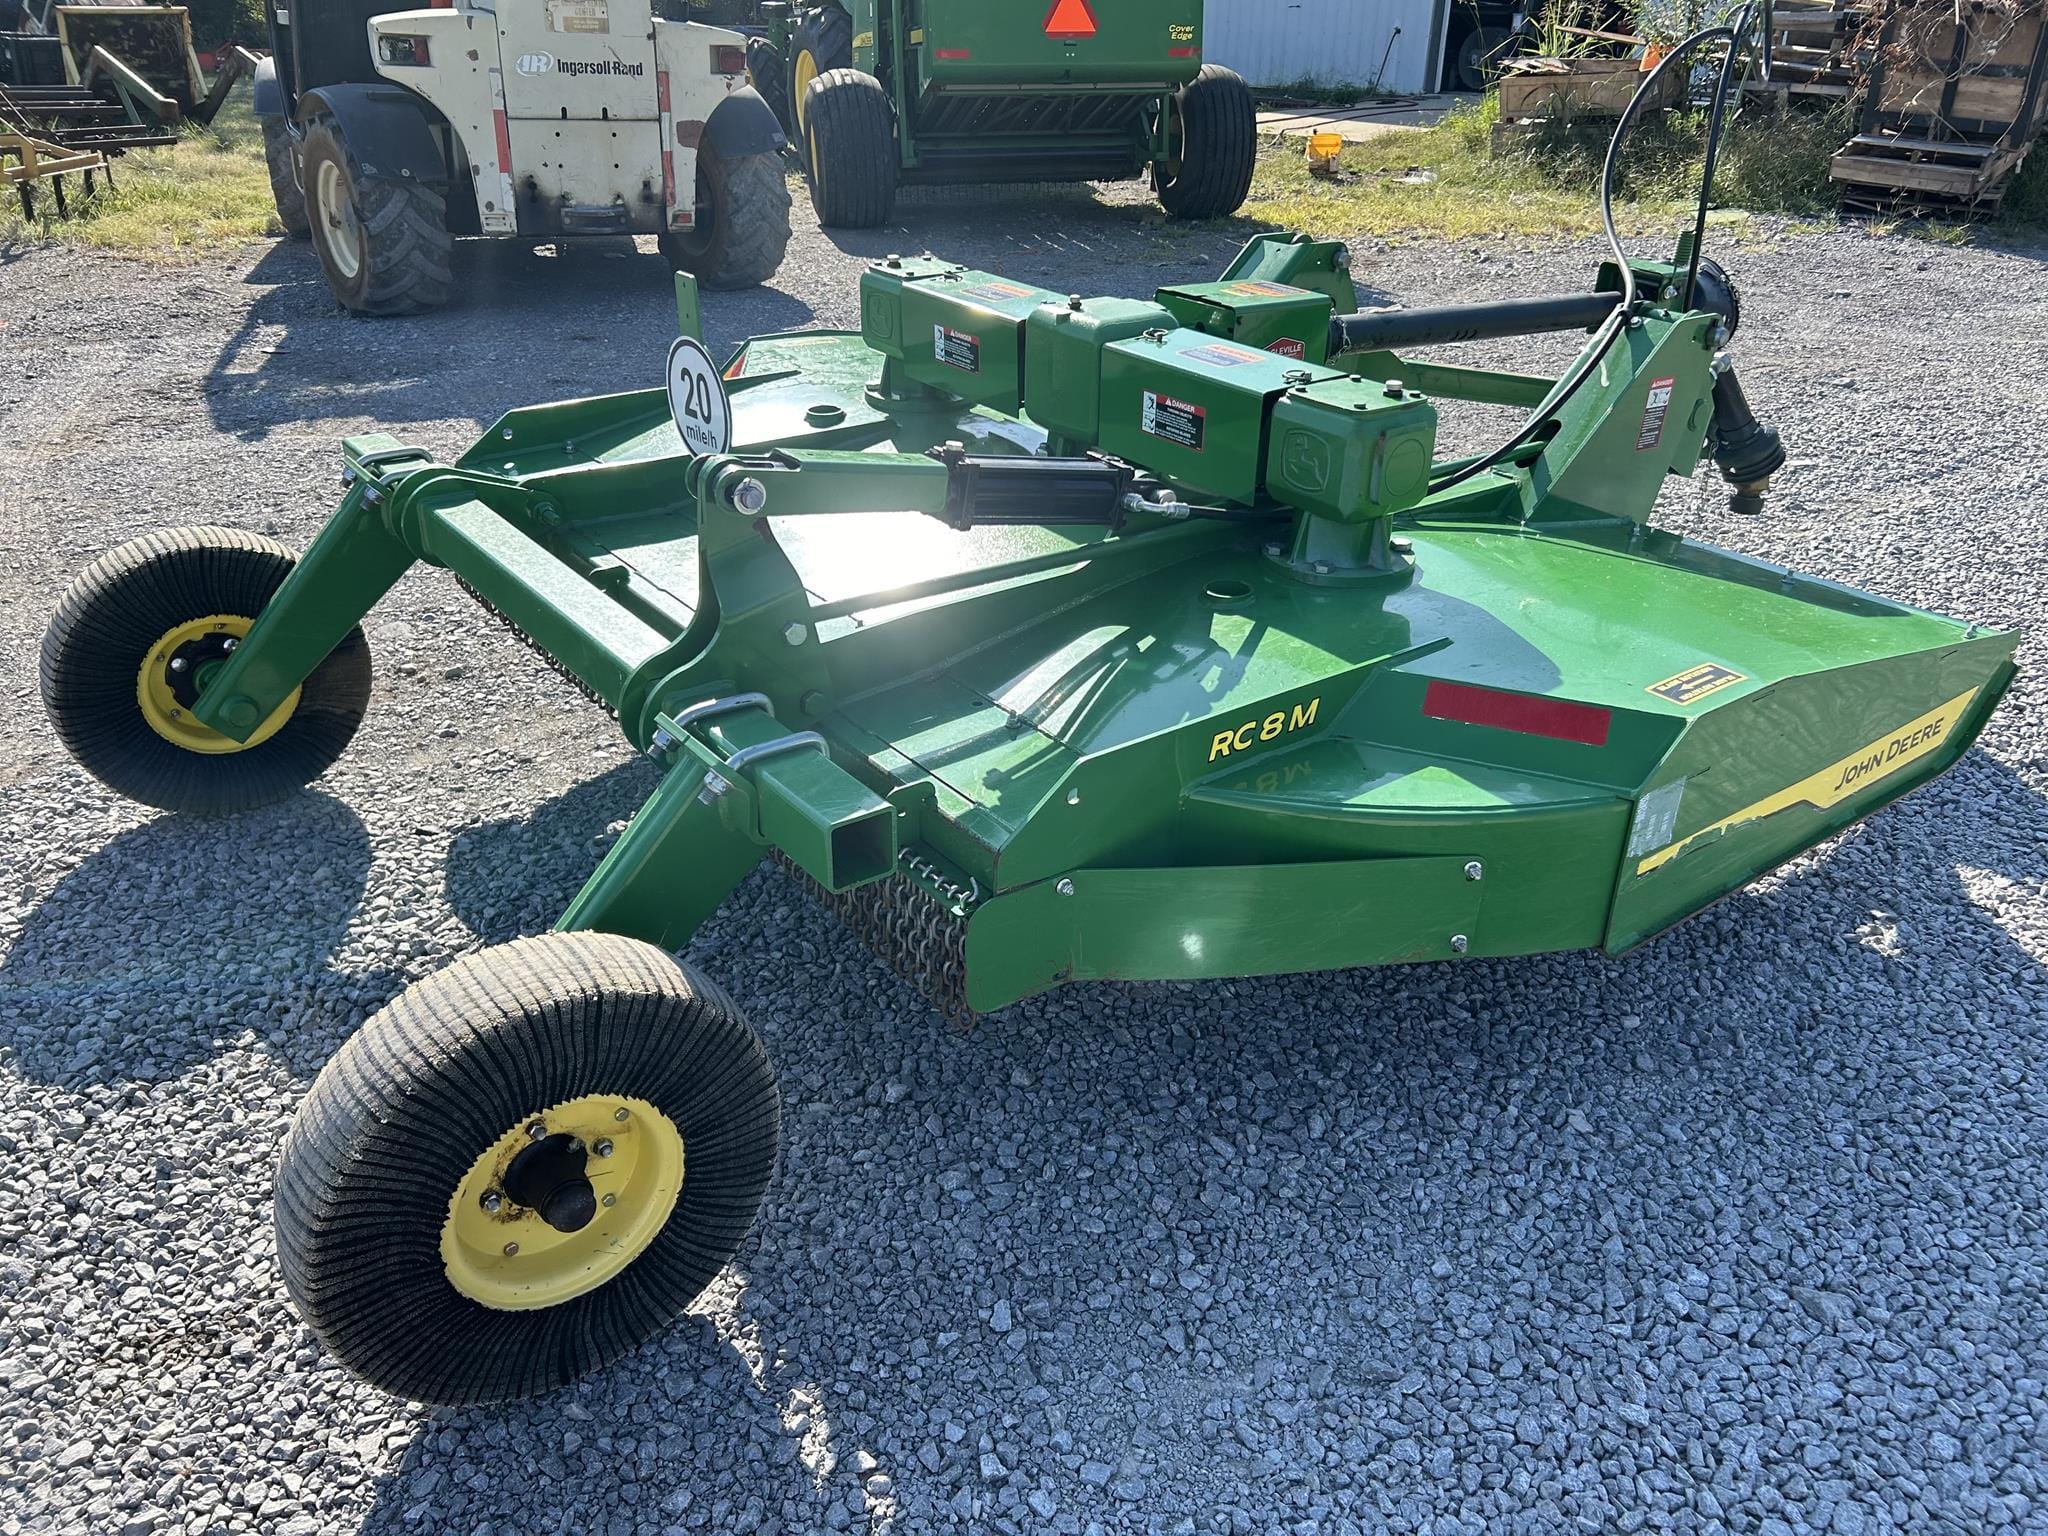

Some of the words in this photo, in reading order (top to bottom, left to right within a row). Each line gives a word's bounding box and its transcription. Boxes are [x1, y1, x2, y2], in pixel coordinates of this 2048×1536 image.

[1169, 24, 1194, 32] Cover
[1171, 32, 1193, 41] Edge
[680, 367, 712, 425] 20
[1171, 399, 1195, 414] DANGER
[686, 424, 718, 449] mile/h
[1834, 750, 1885, 791] JOHN
[1885, 716, 1945, 763] DEERE
